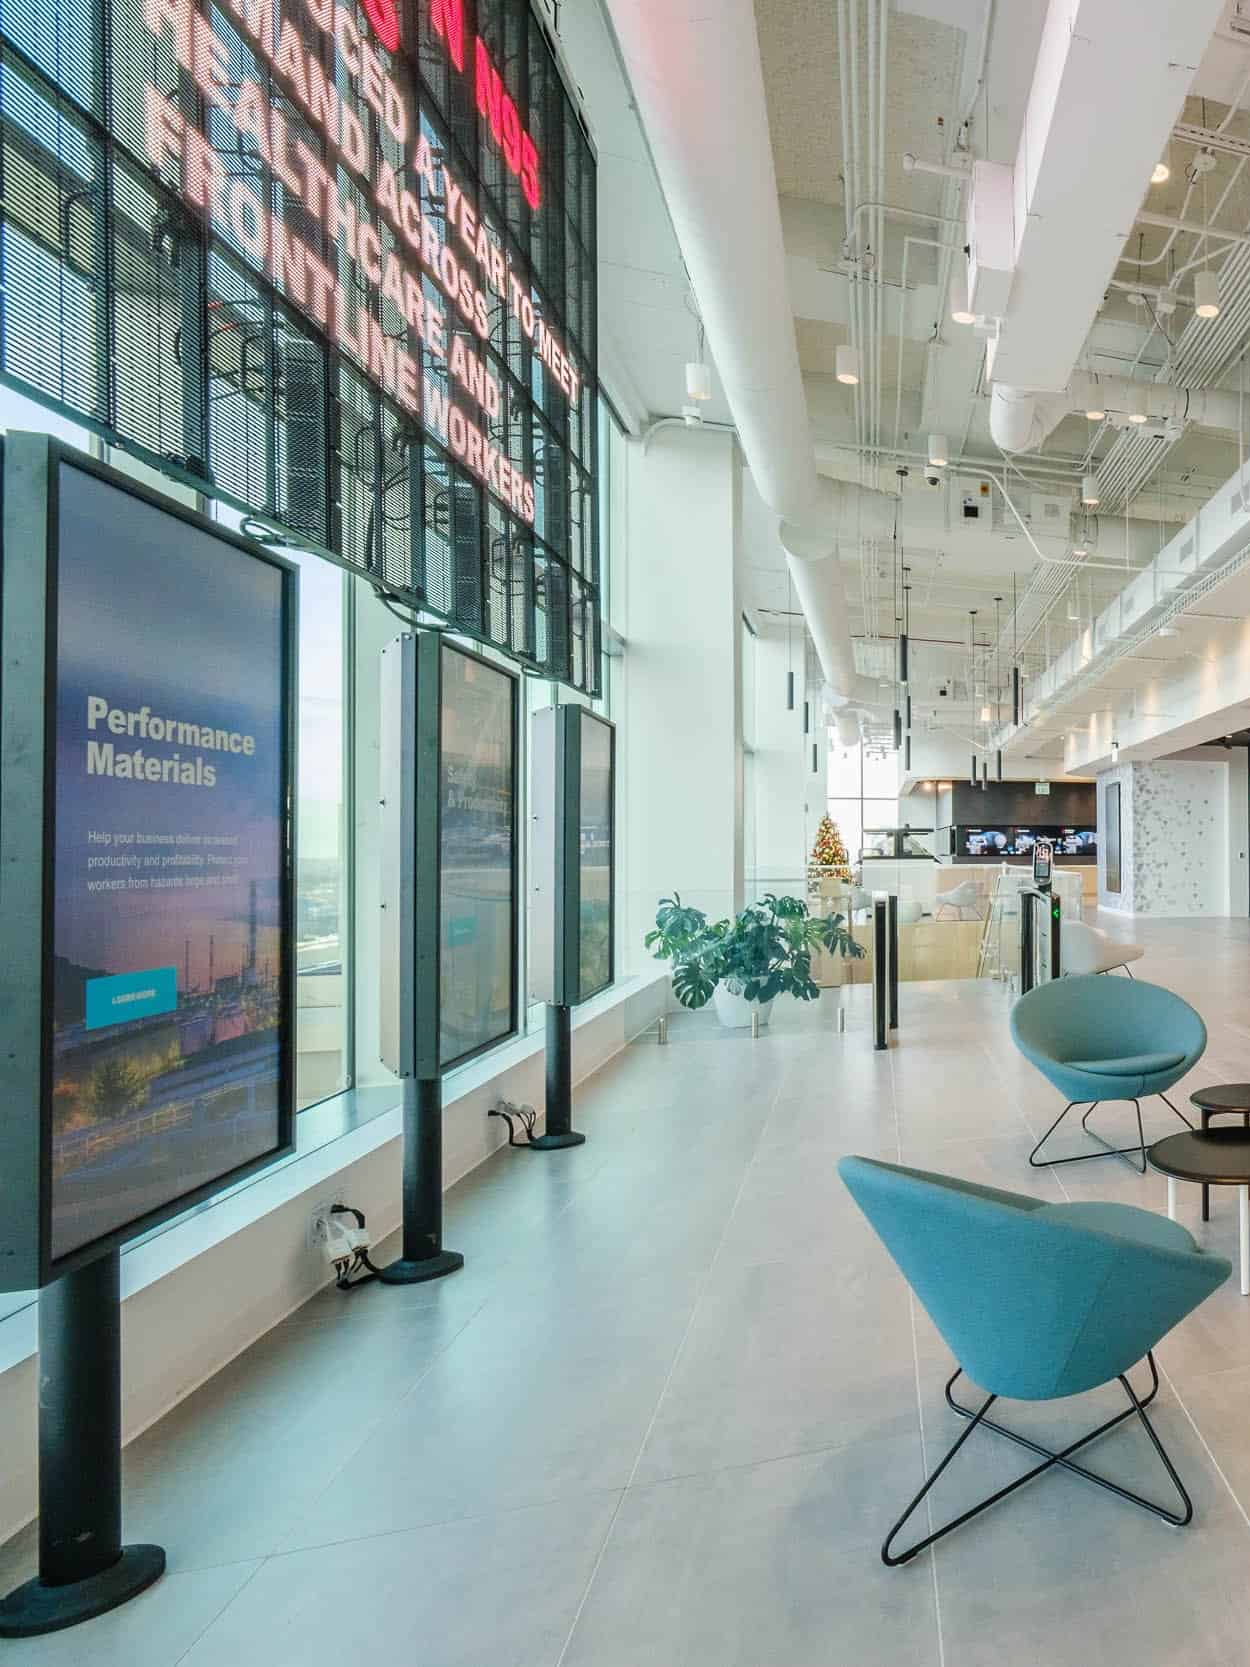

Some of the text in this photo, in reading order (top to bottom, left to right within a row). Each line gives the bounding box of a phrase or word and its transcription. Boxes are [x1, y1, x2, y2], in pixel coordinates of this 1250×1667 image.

[474, 35, 541, 211] N95
[376, 160, 488, 340] ACROSS
[413, 134, 437, 197] A
[441, 164, 507, 299] YEAR
[509, 271, 534, 338] TO
[537, 319, 580, 404] MEET
[144, 82, 535, 525] FRONTLINE WORKERS
[451, 335, 499, 417] AND
[87, 696, 255, 756] Performance
[87, 741, 216, 787] Materials
[88, 831, 111, 846] Help
[88, 855, 141, 870] productivity
[144, 855, 160, 866] and
[88, 879, 126, 892] workers
[128, 877, 149, 890] from
